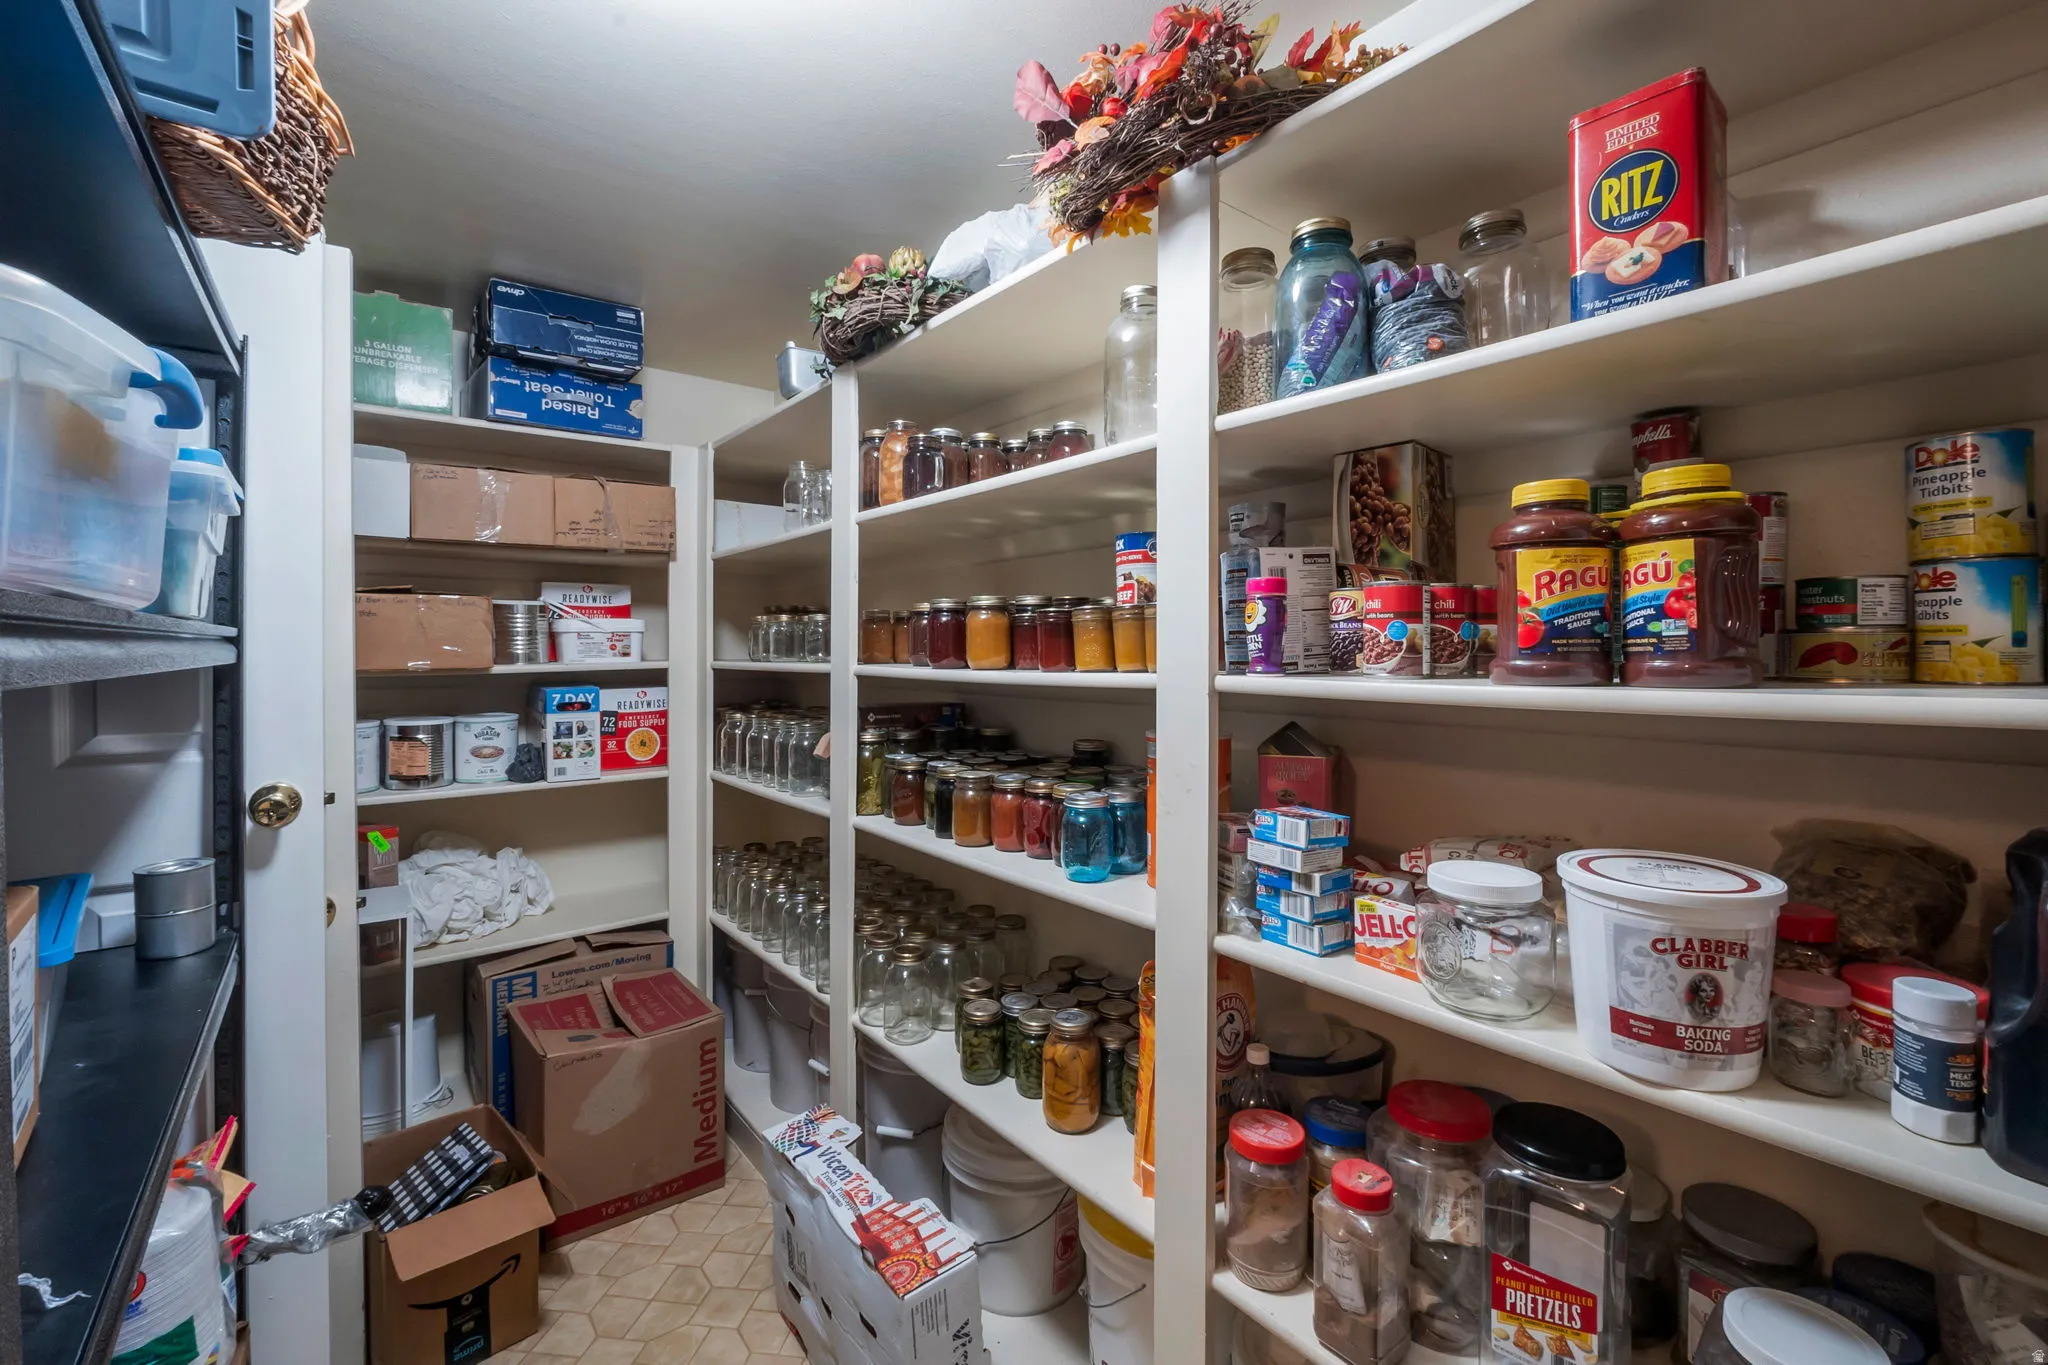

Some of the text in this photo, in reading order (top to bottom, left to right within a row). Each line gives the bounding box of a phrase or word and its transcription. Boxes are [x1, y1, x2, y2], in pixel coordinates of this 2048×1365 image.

[1605, 114, 1659, 141] LIMITED
[1606, 125, 1658, 151] EDITION
[1601, 159, 1664, 221] RITZ
[1613, 208, 1649, 227] Crackers
[496, 284, 525, 296] drive
[354, 346, 422, 364] UNBREAKABLE
[373, 341, 412, 354] GALLON
[389, 361, 439, 375] DISPENSER
[524, 380, 565, 397] Seat
[541, 398, 599, 420] Raised
[1915, 440, 1980, 469] Dole
[1913, 467, 1987, 488] Pineapple
[1920, 483, 1973, 499] Tidbits
[562, 593, 613, 605] READYWISE
[1366, 599, 1382, 610] chili
[1434, 600, 1455, 610] chili
[1553, 609, 1601, 627] TRADITIONAL
[1567, 619, 1592, 630] SAUCE
[552, 693, 596, 705] 7 DAY
[617, 699, 667, 710] READYWISE
[602, 716, 616, 728] 72
[618, 718, 666, 729] FOOD SUPPLY
[607, 741, 617, 749] 32
[1355, 914, 1416, 939] JELL-O
[1650, 937, 1749, 960] CLABBER
[551, 952, 653, 979] Lowes.com/Moving
[1677, 953, 1729, 971] GIRL
[496, 980, 509, 1037] MEDIANA
[1676, 1025, 1731, 1041] BAKING
[1684, 1040, 1723, 1053] SODA
[1950, 1072, 1972, 1080] MEAT
[692, 1037, 717, 1164] Medium
[817, 1146, 874, 1207] VicenTico
[821, 1171, 837, 1187] Fresh
[1496, 1276, 1593, 1307] PEANUT BUTTER FILLED
[1505, 1287, 1582, 1329] PRETZELS
[452, 1337, 484, 1361] prime
